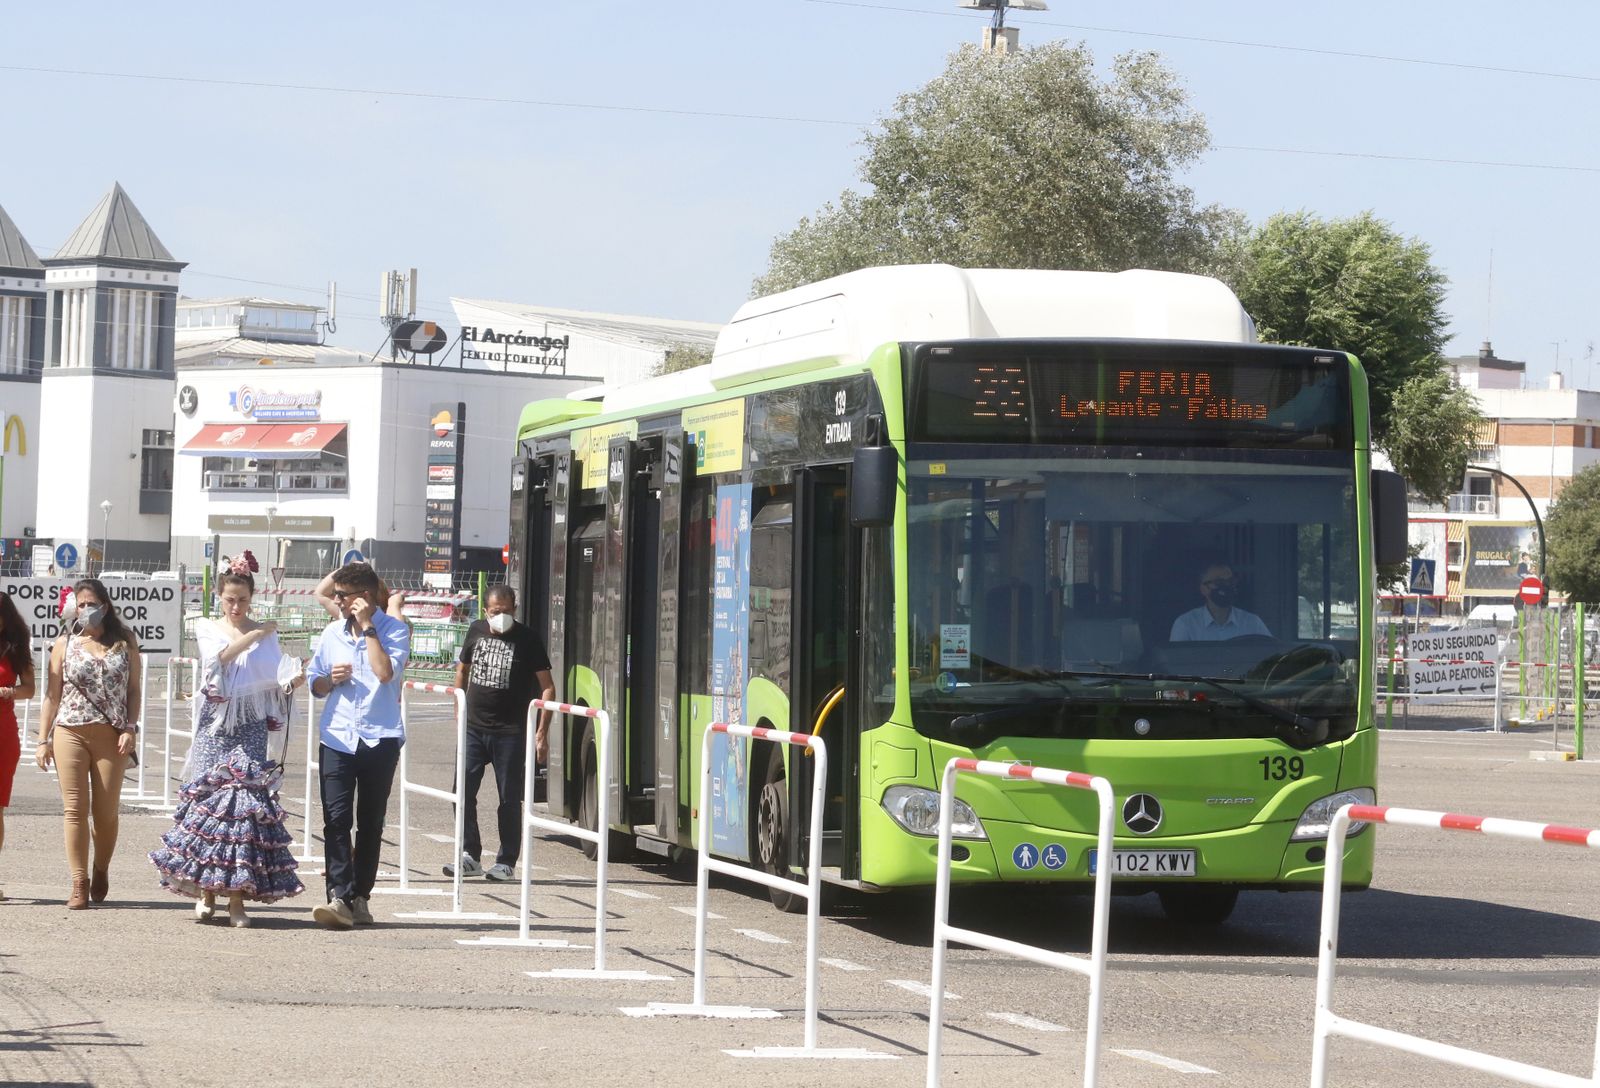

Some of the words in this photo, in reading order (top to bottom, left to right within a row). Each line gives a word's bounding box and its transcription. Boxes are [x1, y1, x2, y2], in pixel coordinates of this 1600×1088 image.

[461, 326, 477, 341] El
[481, 328, 569, 351] Arcángel
[462, 349, 501, 361] CENTRO
[506, 353, 564, 366] COMERCIAL
[1119, 371, 1210, 395] FERIA
[835, 390, 846, 416] 139
[1061, 394, 1161, 418] Levante
[825, 421, 852, 444] ENTRADA
[430, 440, 454, 448] REPSOL
[1475, 551, 1505, 560] BRUGAL
[7, 585, 44, 600] POR
[49, 586, 63, 600] S
[109, 587, 174, 602] URIDAD
[32, 624, 68, 639] LIDA
[1412, 639, 1431, 652] POR
[1433, 638, 1444, 651] SU
[1446, 634, 1496, 650] SEGURIDAD
[1414, 669, 1447, 685] SALIDA
[1449, 665, 1495, 682] PEATONES
[1259, 756, 1304, 781] 139
[1206, 797, 1254, 805] CITARO
[1112, 854, 1150, 871] 102
[1156, 854, 1191, 871] KWV
